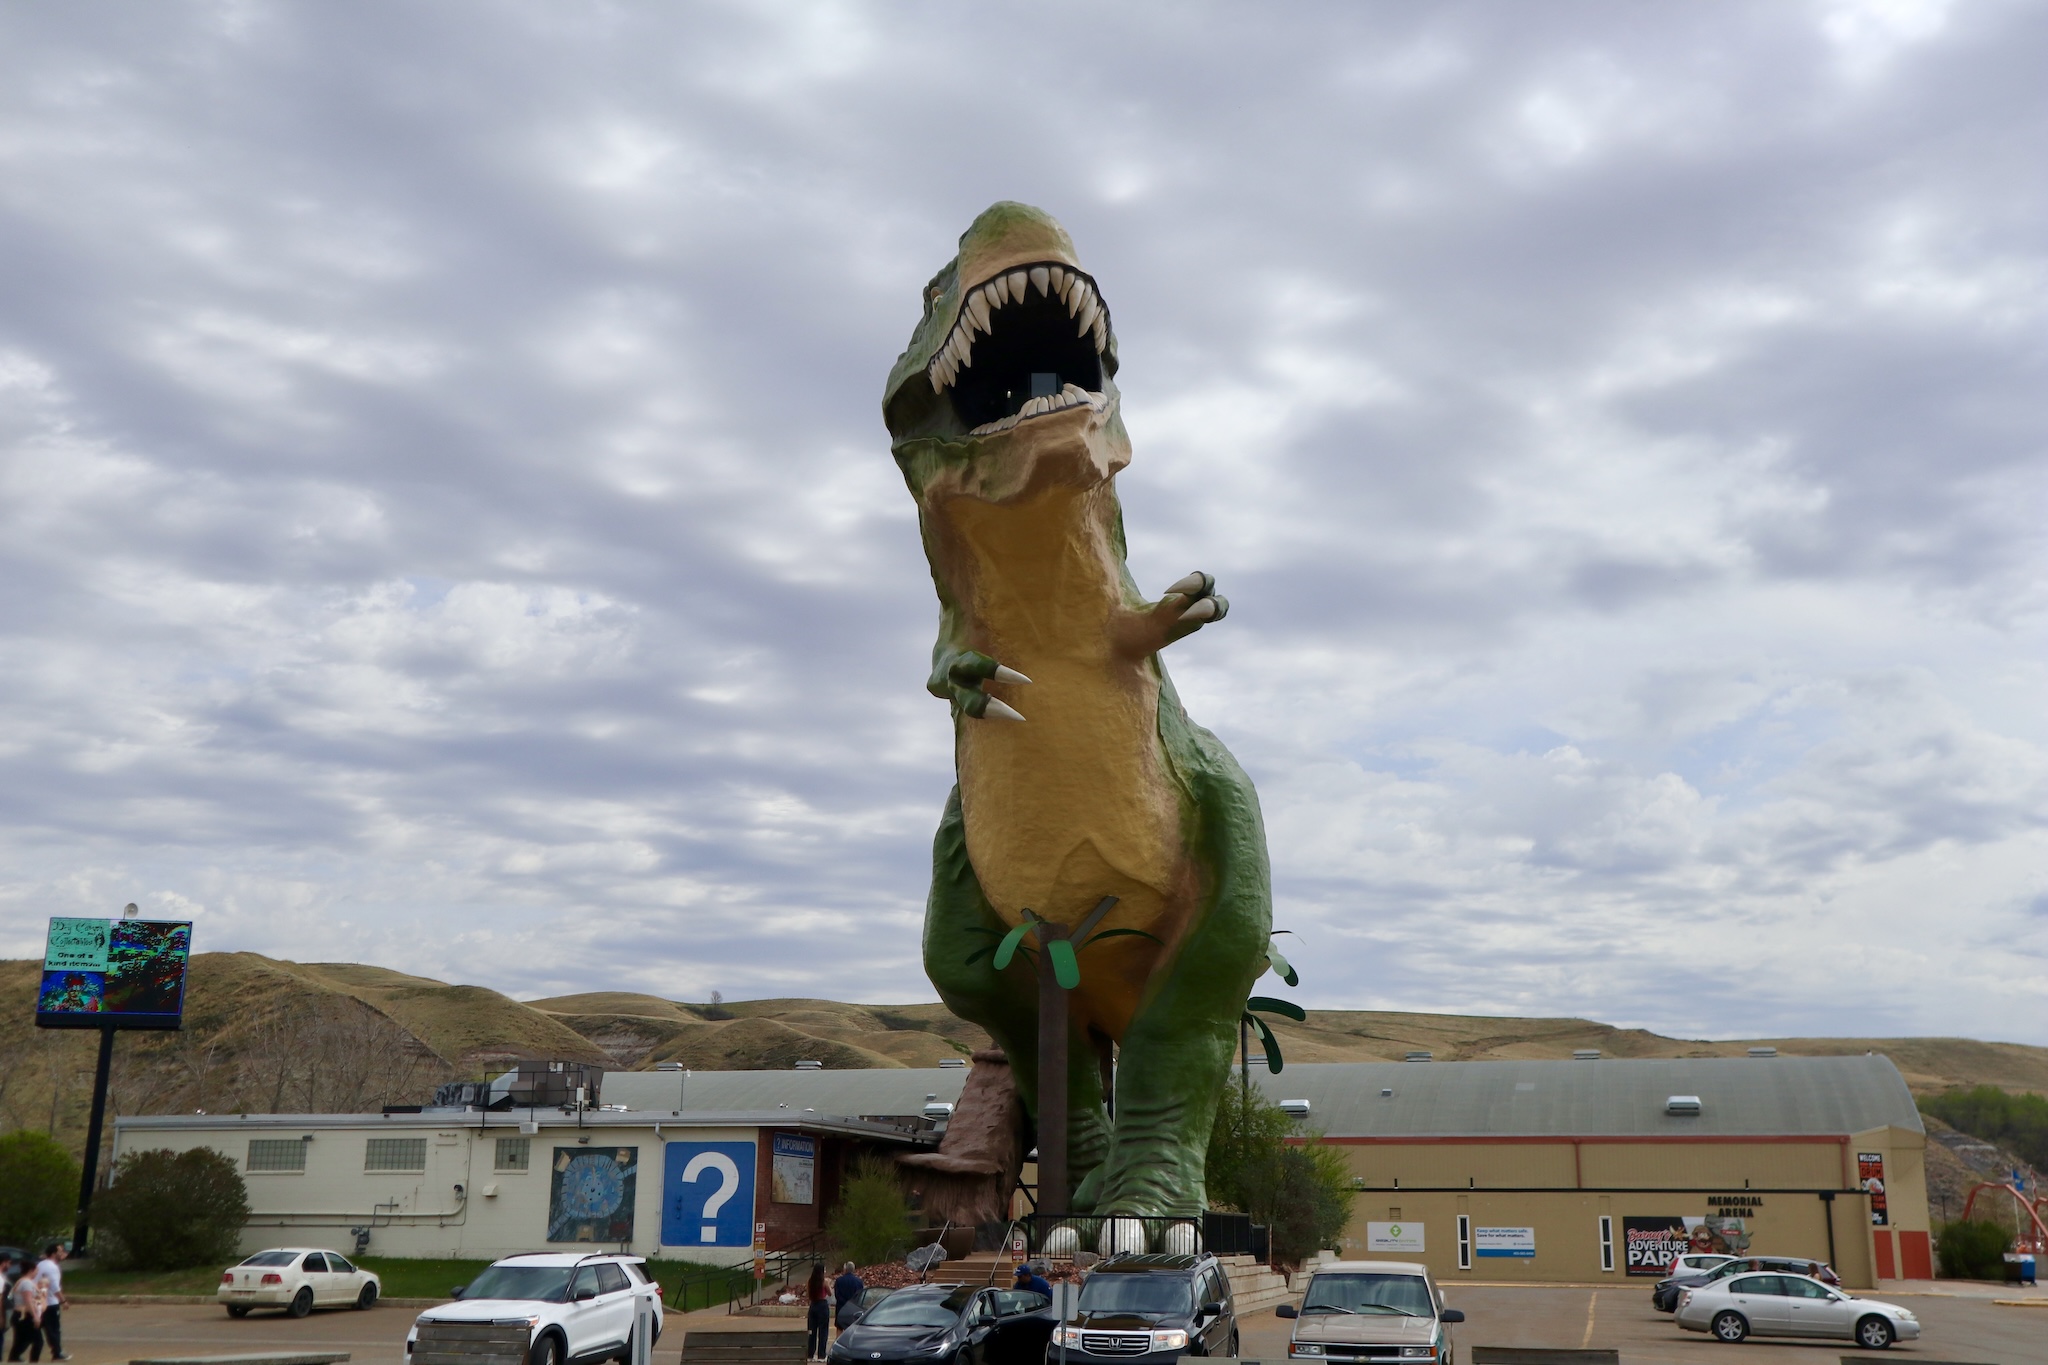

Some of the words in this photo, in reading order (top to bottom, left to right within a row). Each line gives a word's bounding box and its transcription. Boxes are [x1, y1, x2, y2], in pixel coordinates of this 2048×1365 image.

[781, 1138, 814, 1153] INFORMATION
[1859, 1154, 1881, 1162] WELCOME
[1861, 1166, 1883, 1178] DRUM
[1707, 1196, 1763, 1206] MEMORIAL
[1718, 1208, 1754, 1218] ARENA
[1627, 1227, 1672, 1244] Barney's
[1628, 1240, 1689, 1252] ADVENTURE
